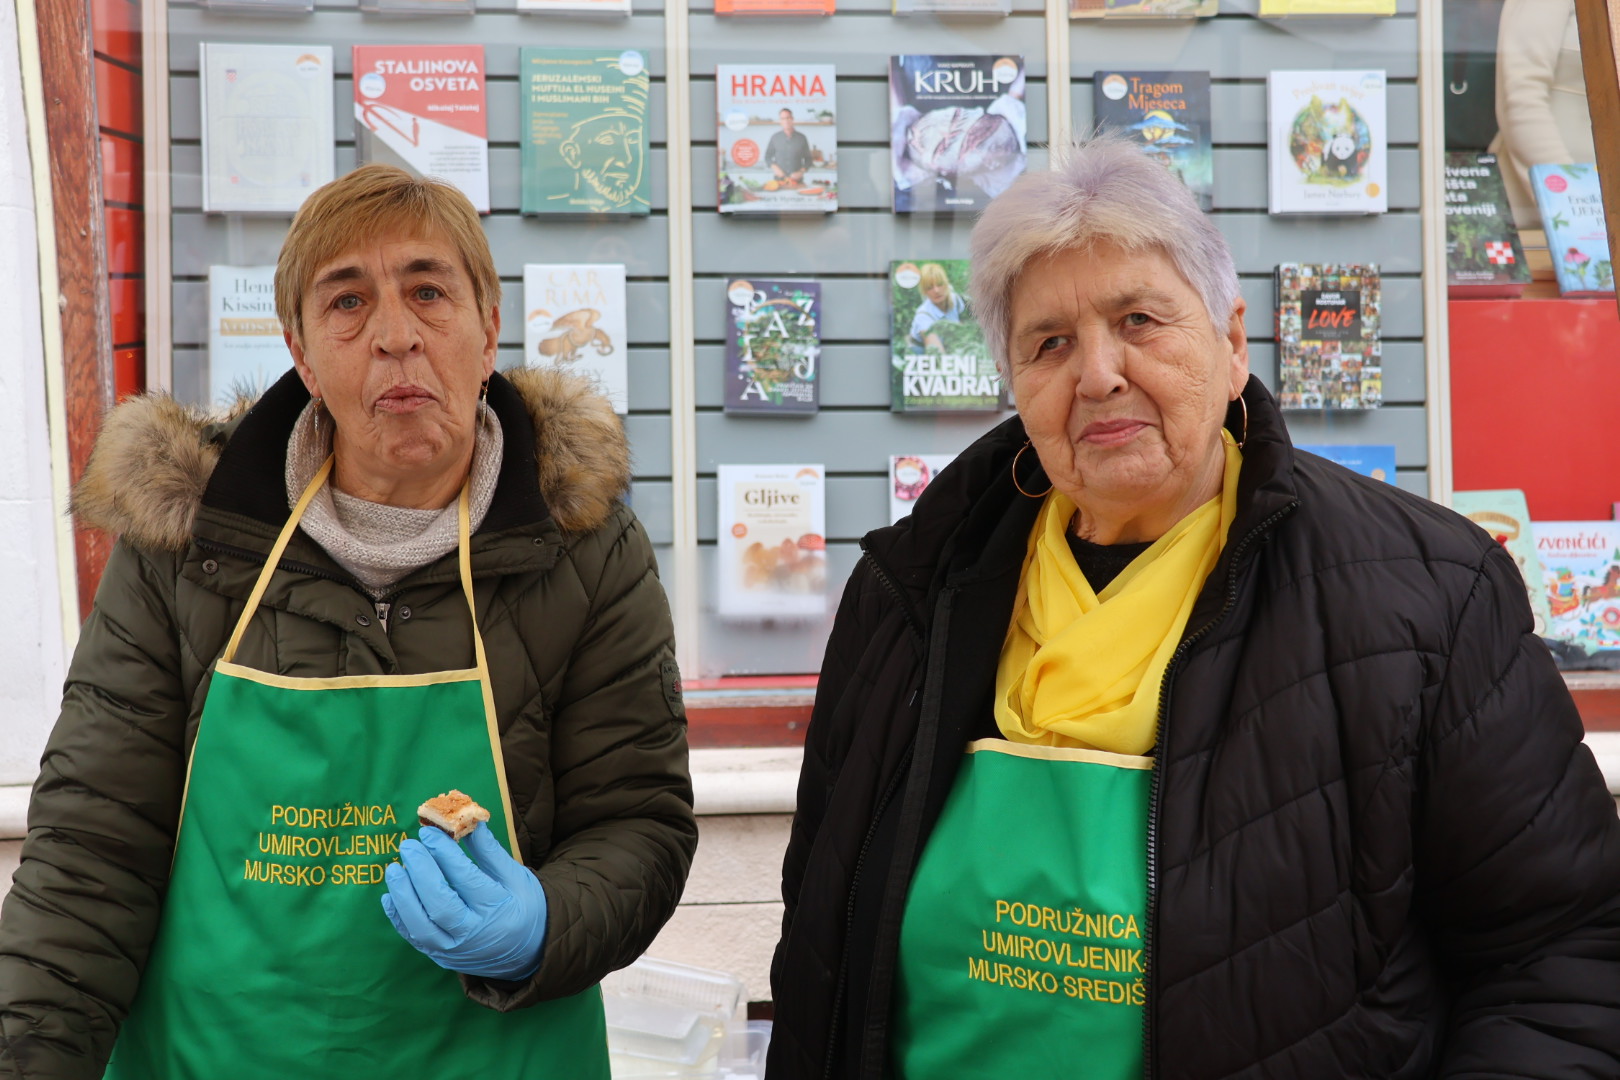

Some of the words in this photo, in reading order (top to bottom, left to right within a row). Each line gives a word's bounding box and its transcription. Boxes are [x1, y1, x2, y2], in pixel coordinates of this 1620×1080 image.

[375, 60, 479, 74] STALJINOVA
[410, 77, 479, 91] OSVETA
[532, 75, 602, 83] JERUZALEMSKI
[731, 74, 827, 97] HRANA
[914, 70, 999, 93] KRUH
[1129, 77, 1183, 98] Tragom
[1128, 93, 1186, 113] Mjeseca
[548, 269, 601, 288] CAR
[545, 287, 609, 306] RIMA
[1308, 306, 1357, 329] LOVE
[903, 355, 977, 376] ZELENI
[903, 375, 1000, 397] KVADRAT
[744, 489, 801, 508] Gljive
[1538, 532, 1607, 550] ZVONČIĆI
[272, 802, 396, 828] PODRUŽNICA
[243, 859, 326, 886] MURSKO
[331, 857, 400, 885] SRED
[996, 899, 1140, 939] PODRUŽNICA
[968, 957, 1059, 994] MURSKO
[1063, 977, 1146, 1006] SREDIŠ
